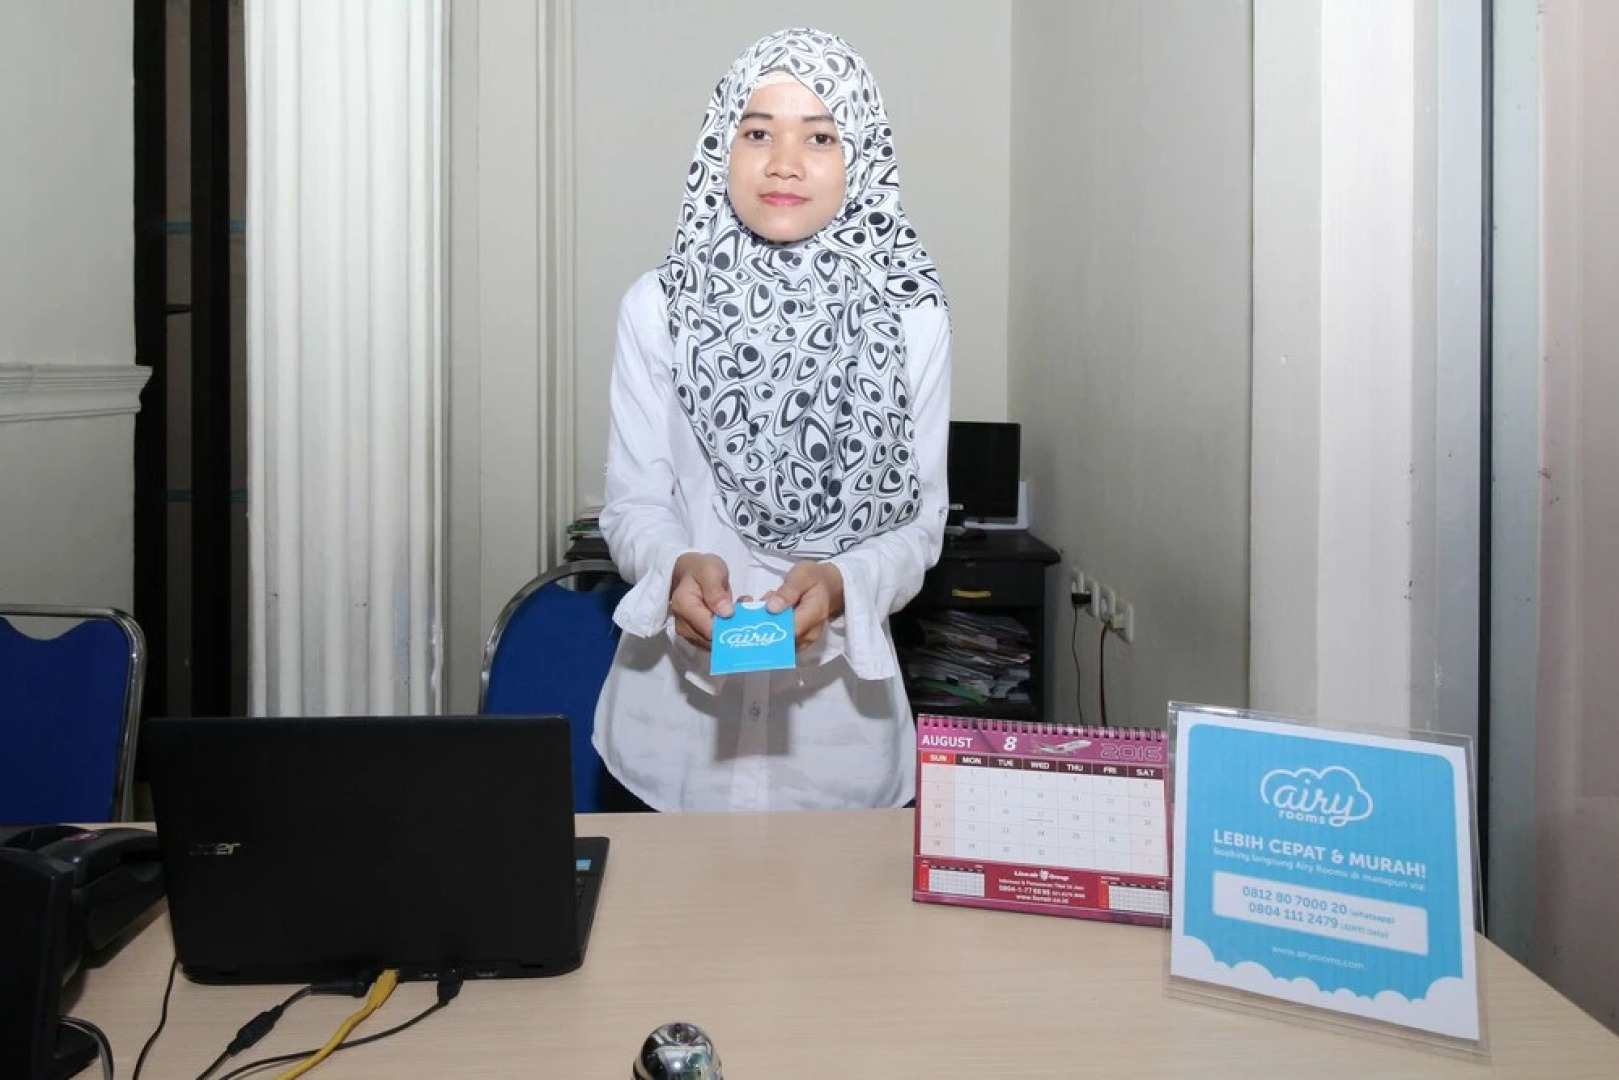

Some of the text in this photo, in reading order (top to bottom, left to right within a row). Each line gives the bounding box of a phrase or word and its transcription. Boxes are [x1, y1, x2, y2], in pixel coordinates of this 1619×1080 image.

[922, 734, 1162, 761] AUGUST 8 2016
[930, 754, 1155, 777] SUN MON TUE WED THU FRI SAT
[1273, 778, 1354, 827] airy
[1278, 810, 1326, 825] rooms
[1213, 829, 1426, 878] LEBIH CEPAT & MURAH!
[1213, 847, 1251, 862] booking
[1253, 855, 1294, 870] langsung
[1295, 861, 1314, 873] Airy
[1315, 864, 1348, 878] Rooms
[1242, 885, 1272, 900] 0812
[1275, 891, 1293, 905] 80
[1294, 894, 1328, 912] 7000
[1331, 901, 1348, 914] 20
[1248, 901, 1280, 917] 0804
[1283, 908, 1304, 922] 111
[1307, 912, 1339, 929] 2479
